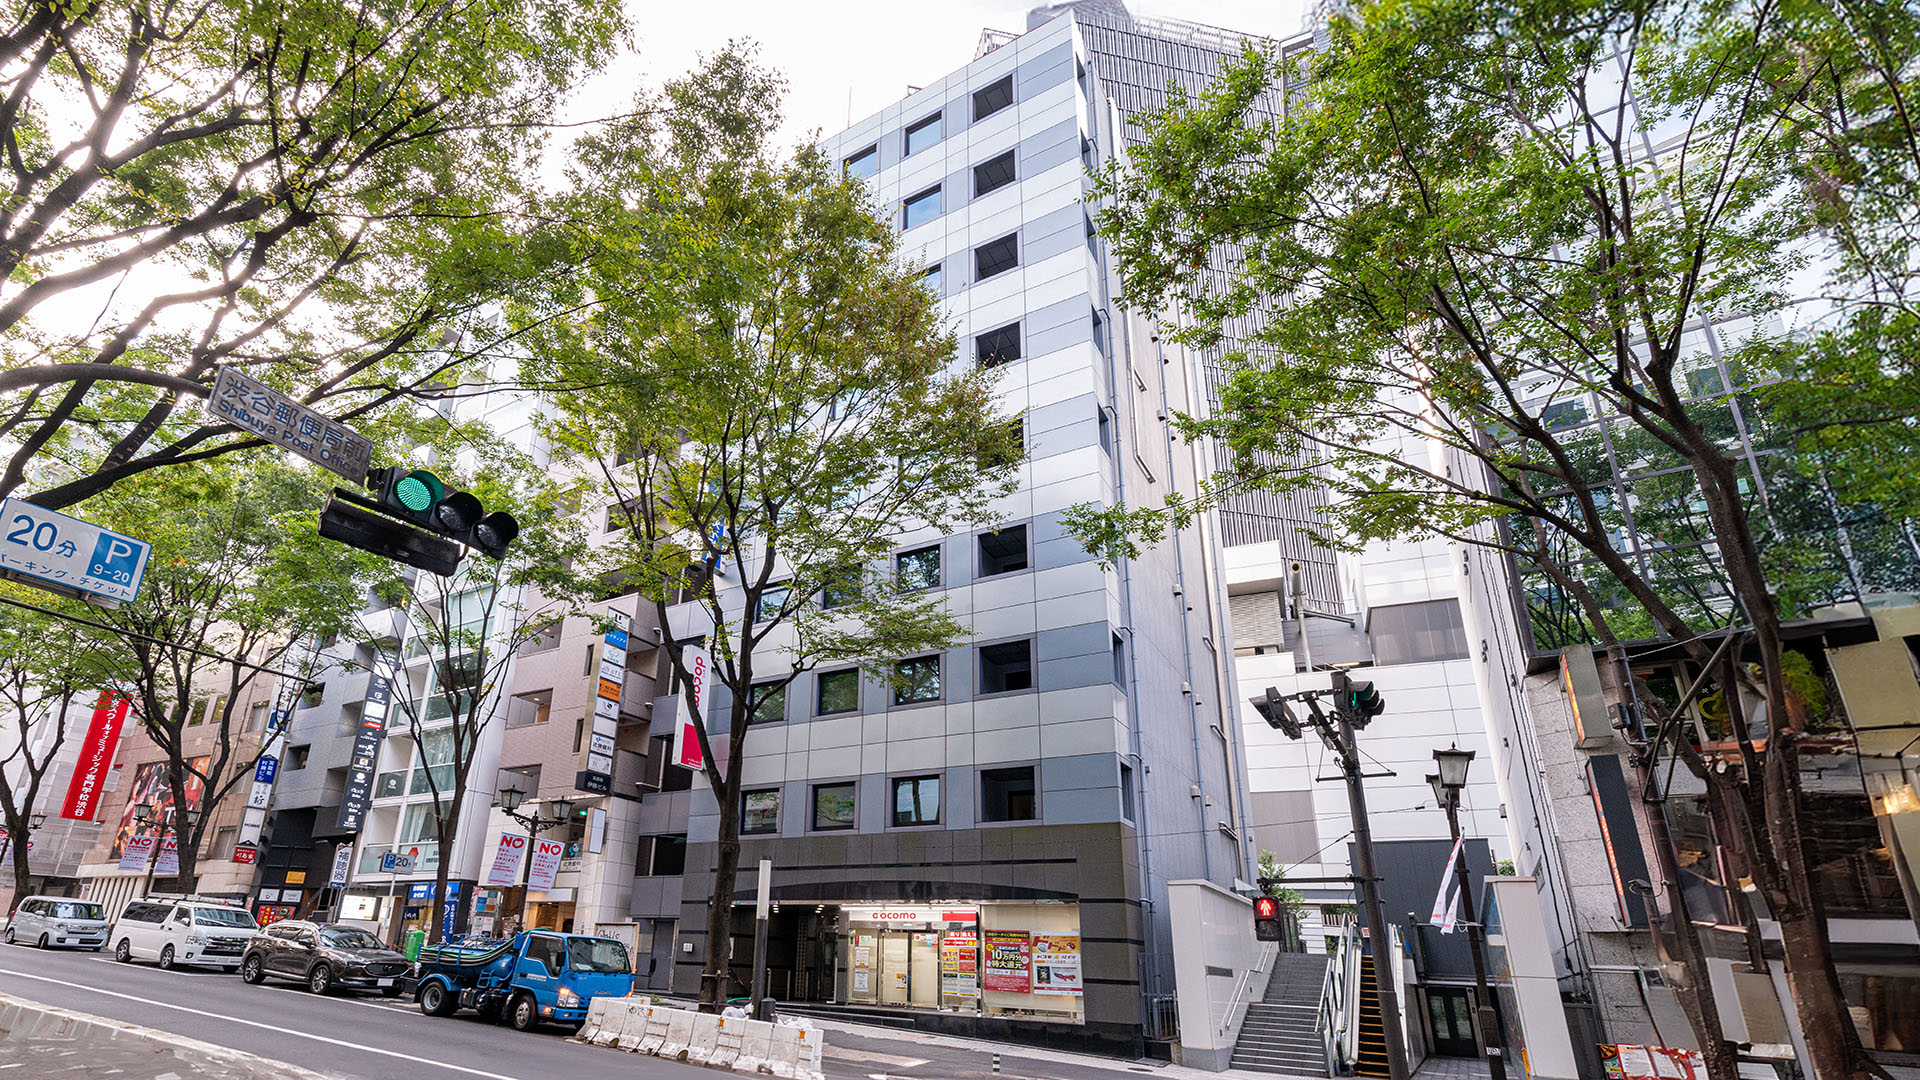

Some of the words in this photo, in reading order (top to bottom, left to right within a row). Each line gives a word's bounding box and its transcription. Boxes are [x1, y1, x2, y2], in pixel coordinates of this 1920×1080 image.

[221, 375, 366, 463] 渋谷郵便局前
[217, 398, 278, 435] Shibuya
[282, 429, 315, 454] Post
[319, 448, 358, 473] Office
[6, 514, 77, 558] 20分
[105, 539, 132, 564] P
[93, 564, 130, 583] 9-20
[129, 837, 153, 846] NO
[165, 841, 177, 849] N
[500, 835, 525, 849] NO
[539, 842, 562, 856] NO
[991, 949, 1022, 960] 10万円分
